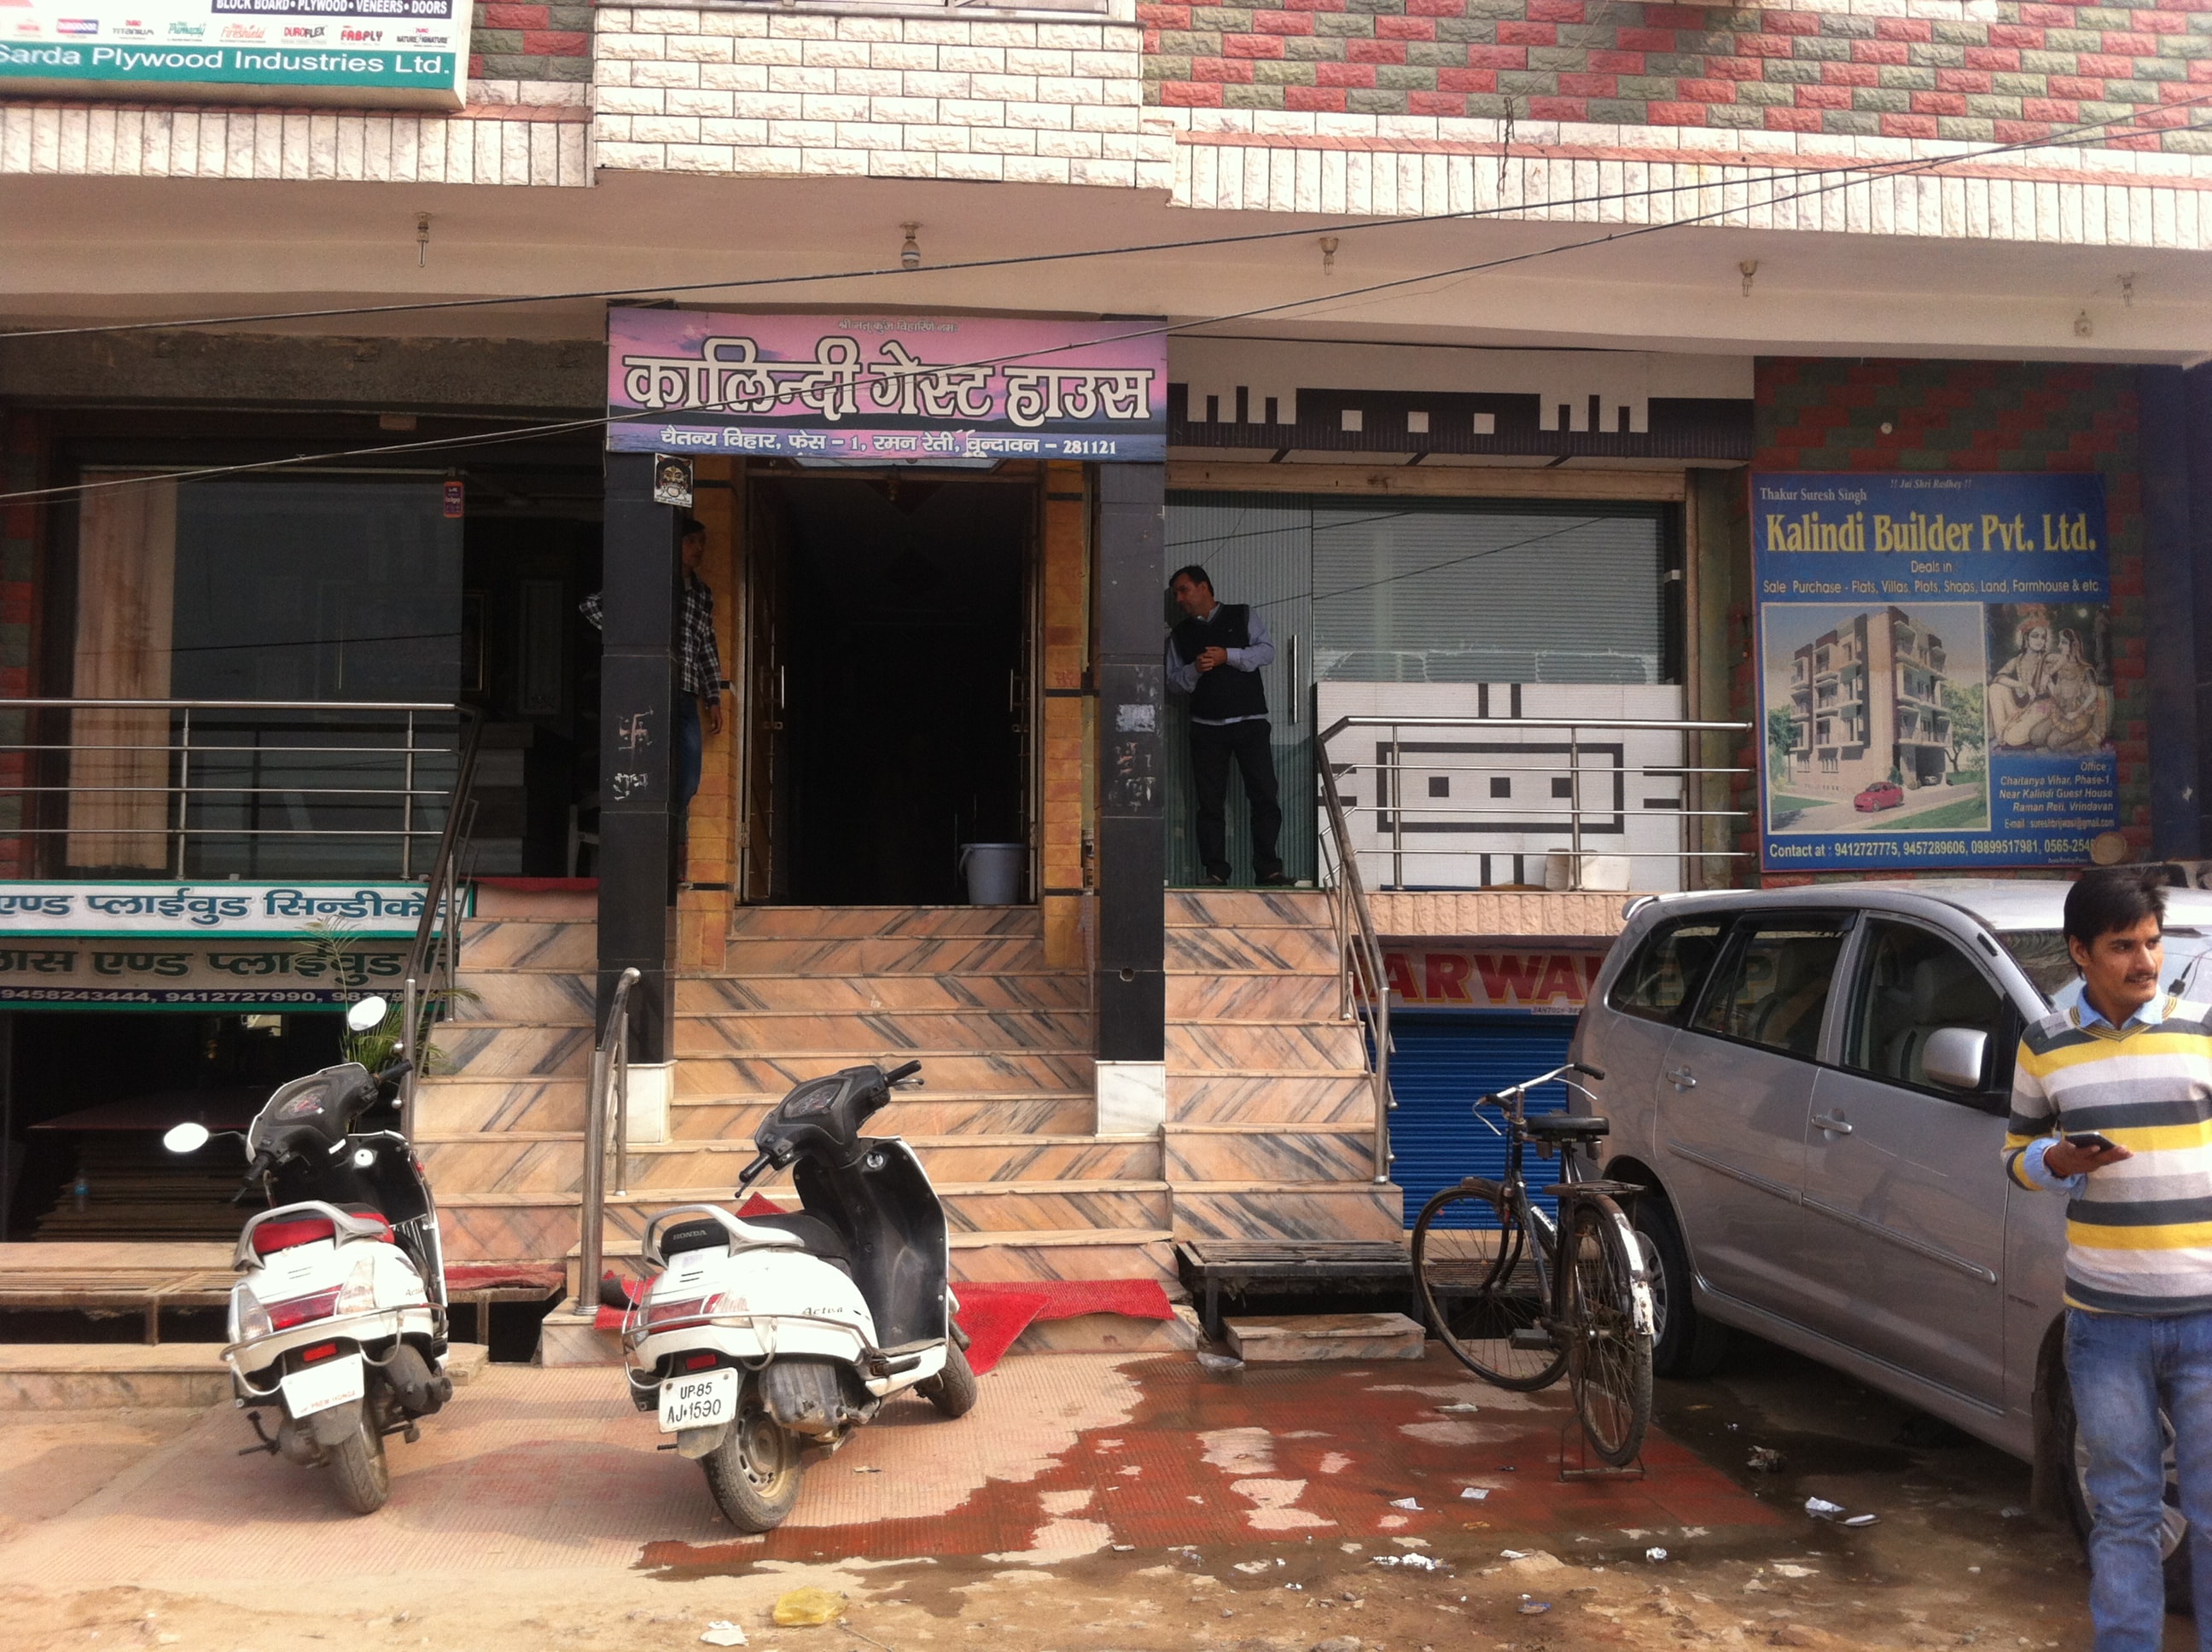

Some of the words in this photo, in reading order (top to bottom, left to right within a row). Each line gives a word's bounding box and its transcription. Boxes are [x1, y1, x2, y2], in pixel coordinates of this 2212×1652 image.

[217, 0, 252, 10] BLOCK
[356, 0, 404, 13] VENEERS
[411, 1, 447, 15] DOORS
[0, 44, 81, 66] Sarda
[92, 47, 224, 71] Plywood
[235, 50, 384, 72] Industries
[395, 55, 450, 75] Ltd.
[622, 335, 862, 422] कालिन्दी
[868, 340, 996, 417] गेस्ट
[1002, 366, 1155, 428] हाउस
[661, 425, 719, 446] चैतन्य
[789, 430, 826, 450] फेस
[873, 434, 917, 451] रमन
[1062, 440, 1116, 455] 281121
[1760, 487, 1797, 502] Thakur
[1801, 488, 1837, 502] Suresh
[1838, 487, 1867, 506] Singh
[1766, 511, 1866, 553] Kalindi
[1872, 511, 1975, 553] Builder
[1982, 514, 2035, 552] Pvt.
[2042, 513, 2097, 552] Ltd.
[1911, 561, 1941, 574] Deals
[1793, 581, 1842, 594] Purchase
[2012, 579, 2069, 593] Farmhouse
[2000, 775, 2046, 787] Chaitanya
[1999, 789, 2021, 800] Near
[2023, 788, 2054, 799] Kalindi
[2056, 788, 2083, 799] Guest
[2084, 788, 2114, 799] House
[2012, 802, 2045, 812] Raman
[2069, 800, 2114, 811] Vrindavan
[1769, 843, 1813, 858] Contact
[1814, 844, 1825, 857] at
[1835, 841, 1901, 858] 9412727775,
[1903, 840, 1969, 856] 9457289606,
[86, 887, 253, 926] प्लाईवुड
[91, 951, 195, 977] एण्ड
[1353, 952, 1606, 1004] ARWA
[2, 989, 158, 1003] 9458243444,
[166, 991, 323, 1003] 9412727990,
[672, 1229, 707, 1241] HONDA
